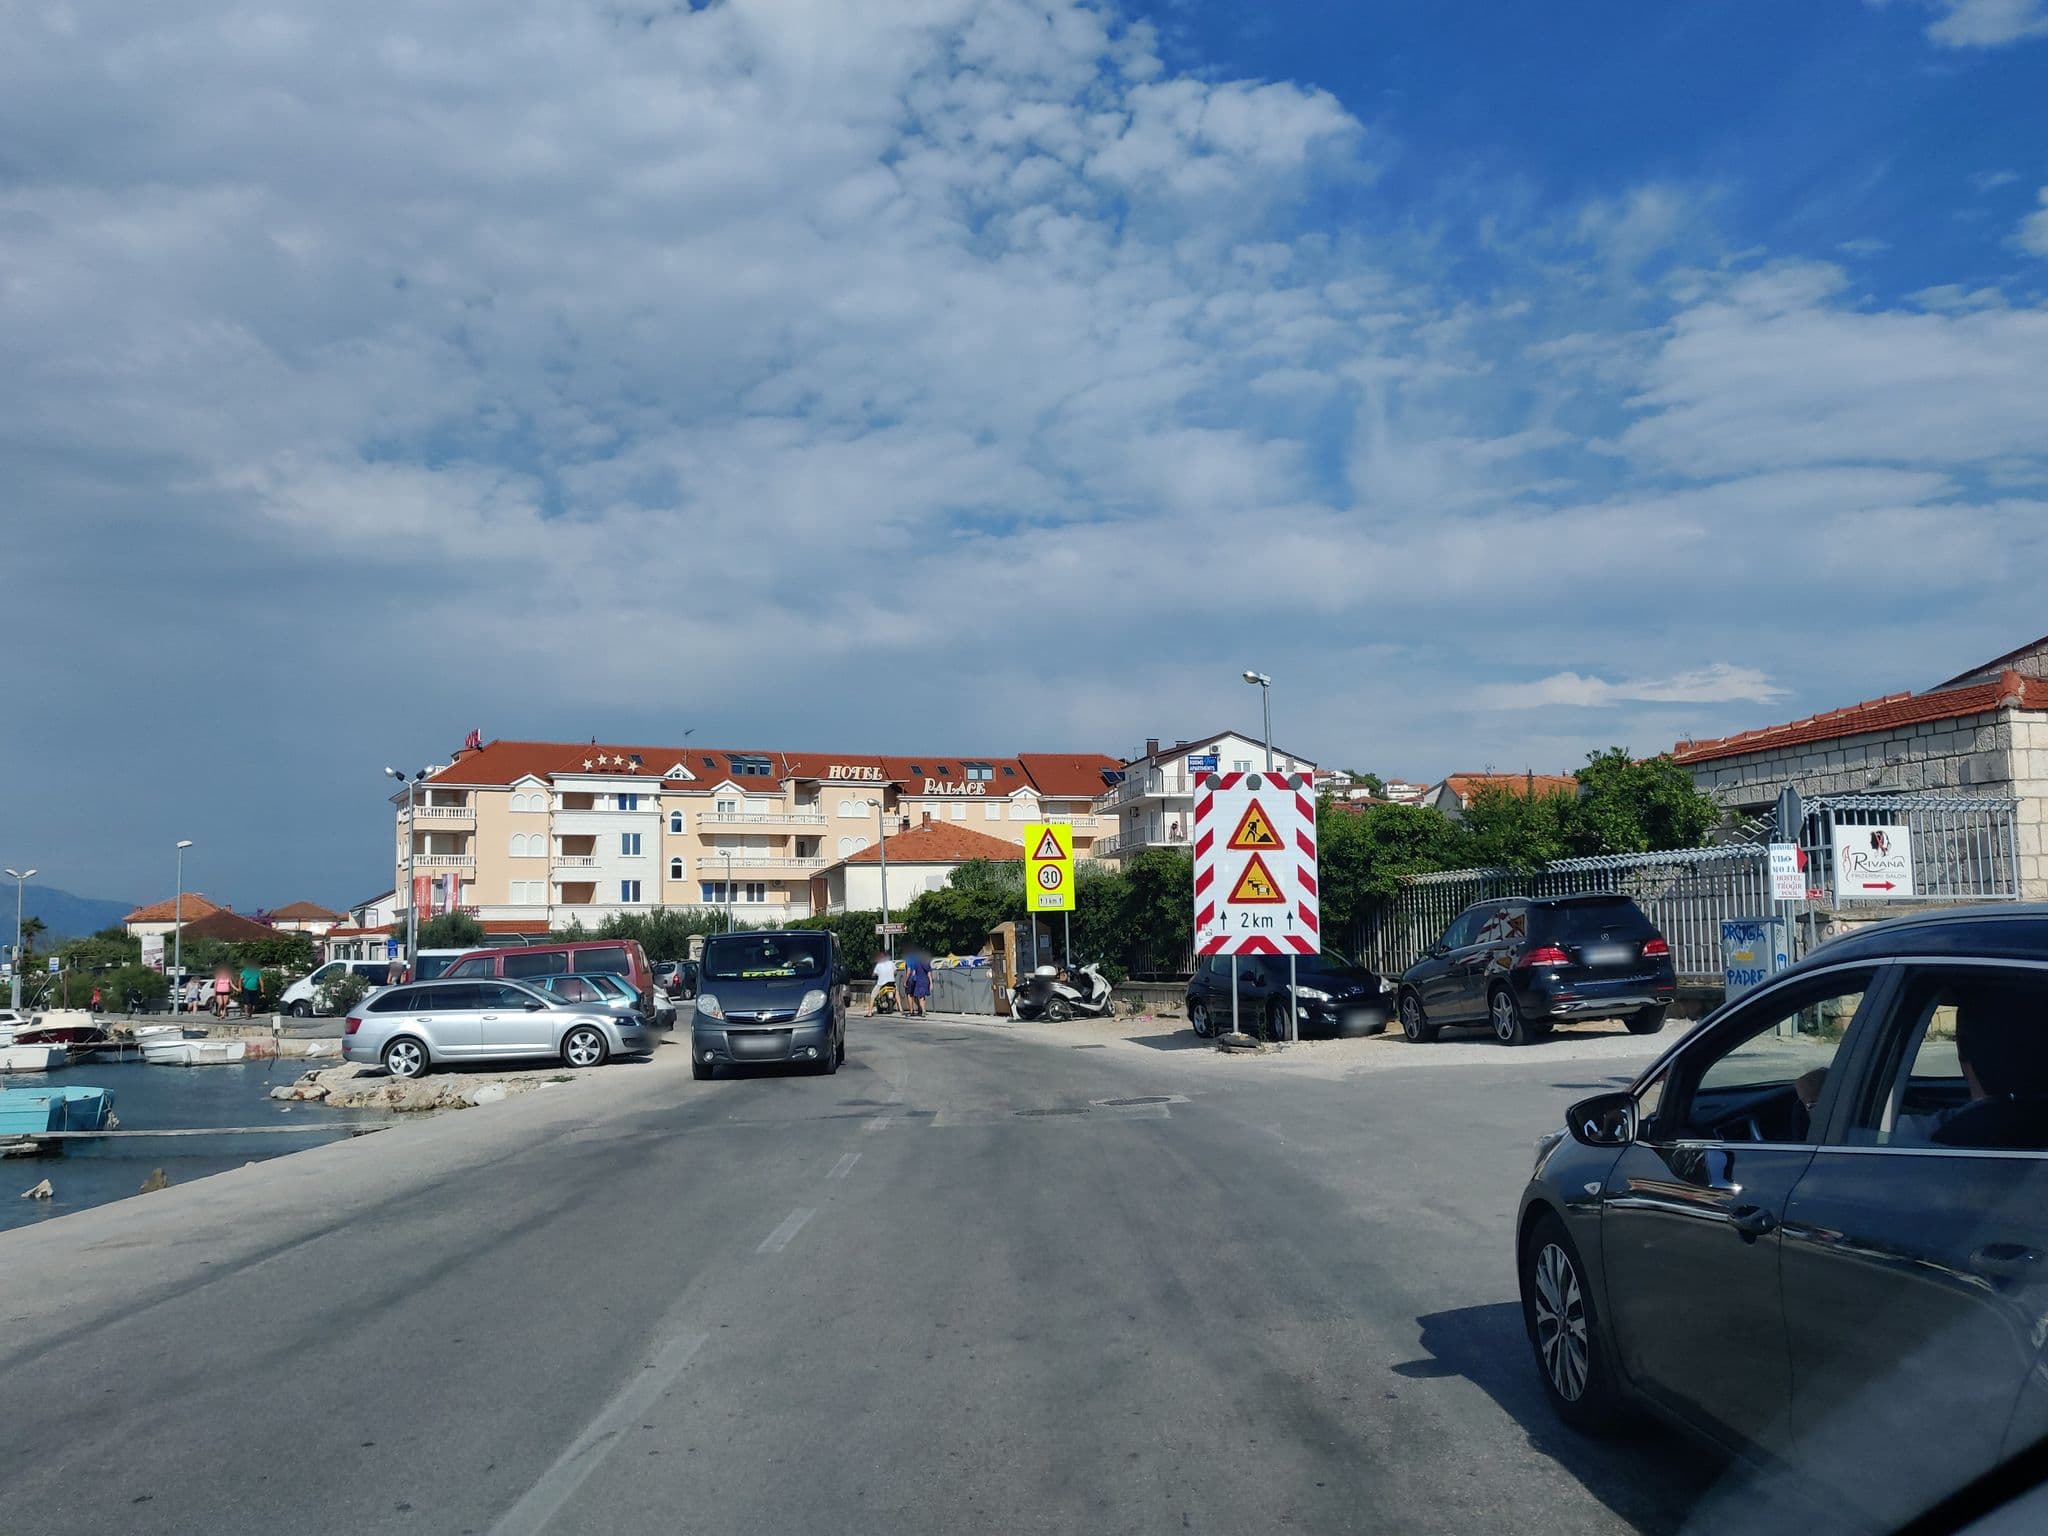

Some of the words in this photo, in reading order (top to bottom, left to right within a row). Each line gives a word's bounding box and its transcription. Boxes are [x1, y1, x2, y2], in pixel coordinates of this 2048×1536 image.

[828, 765, 882, 780] HOTEL
[922, 777, 985, 795] PALACE
[1043, 870, 1058, 884] 30
[1241, 912, 1249, 928] 2
[1252, 912, 1273, 928] km
